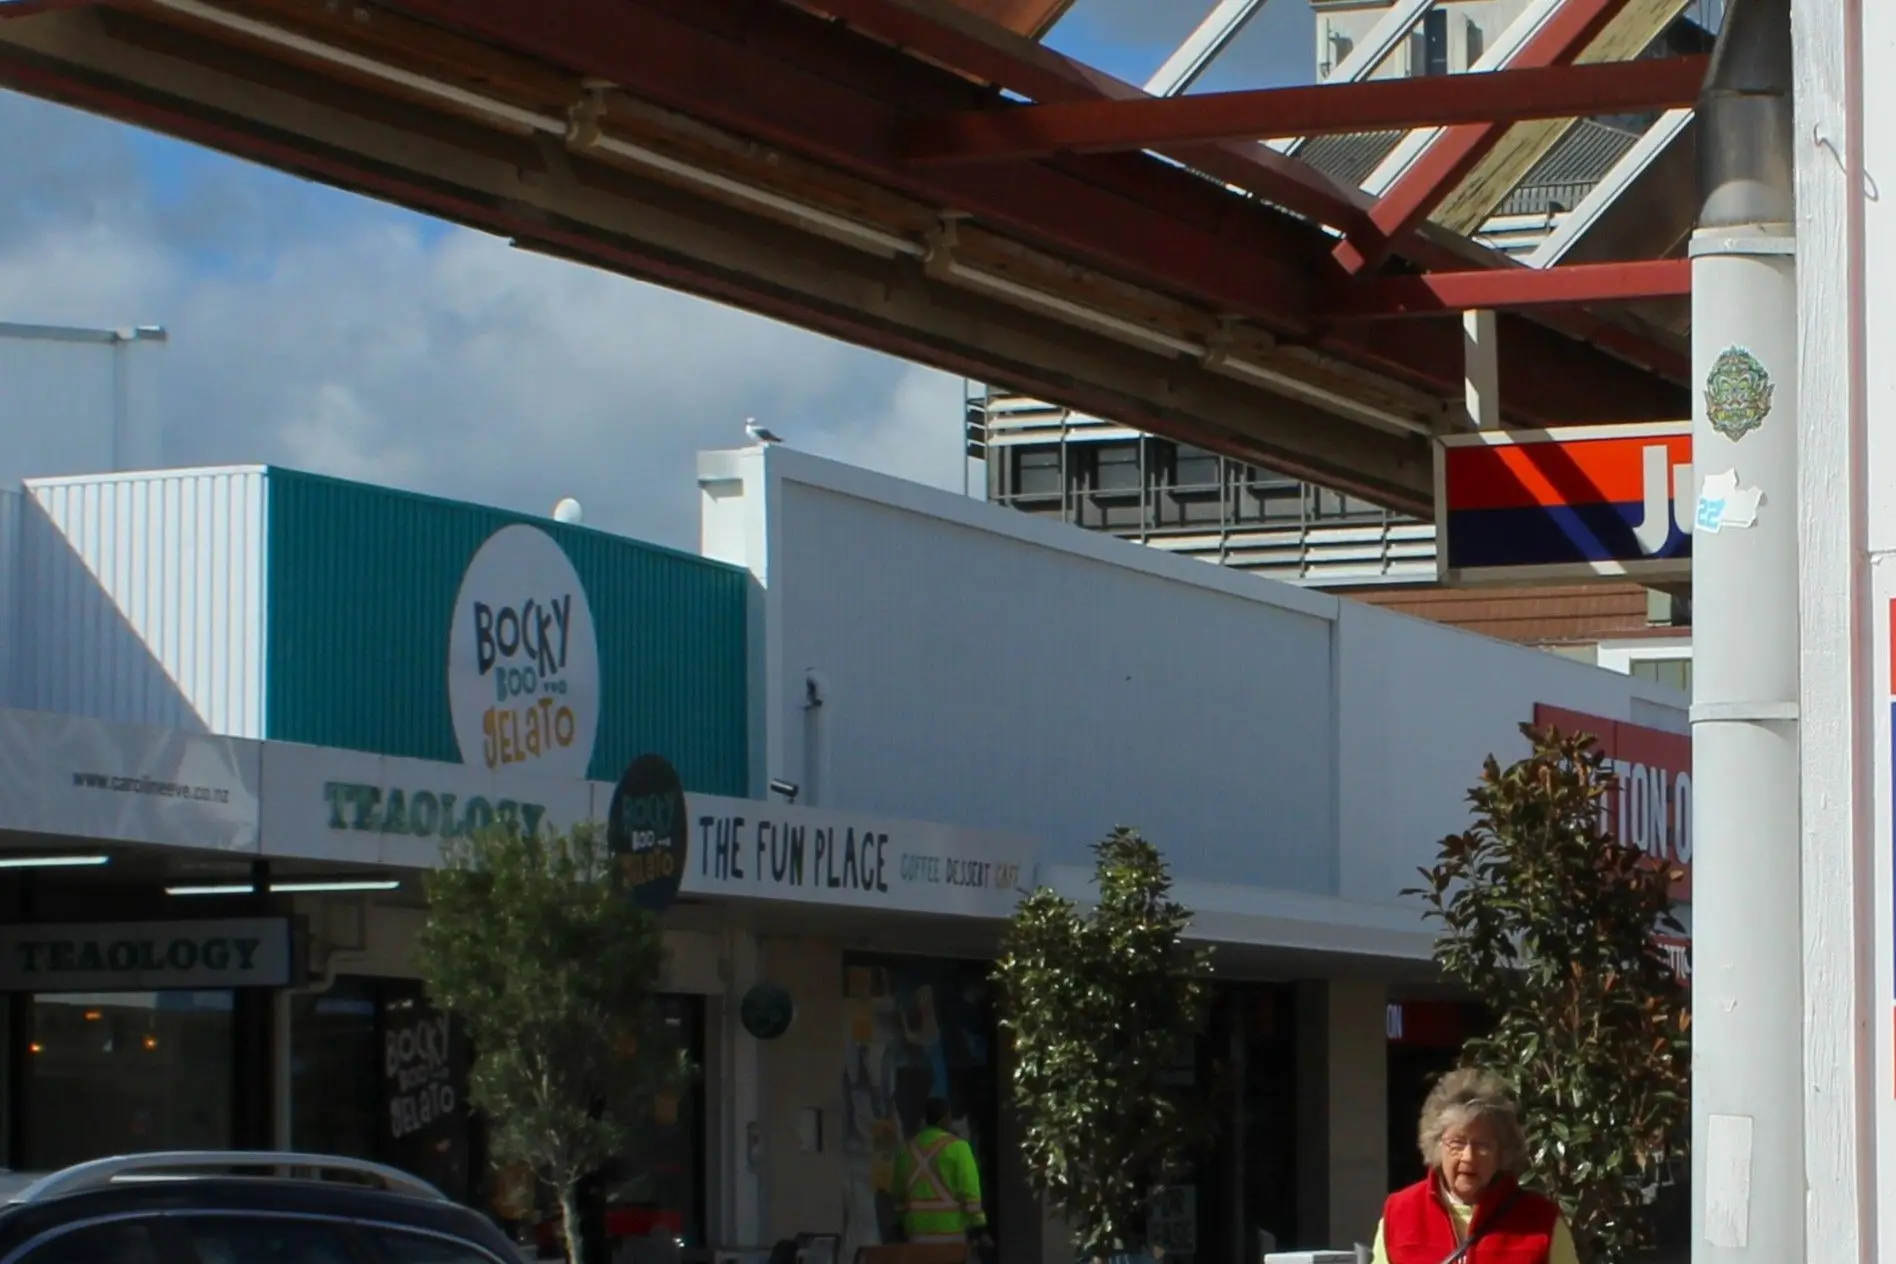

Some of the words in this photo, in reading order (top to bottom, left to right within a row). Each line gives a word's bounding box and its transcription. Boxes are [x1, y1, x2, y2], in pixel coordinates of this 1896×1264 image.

[473, 593, 572, 678] BOCKY
[495, 665, 537, 702] BOO
[1590, 757, 1668, 861] TTON
[699, 816, 745, 881] THE
[756, 820, 805, 886] FUN
[813, 826, 889, 893] PLACE
[946, 857, 991, 888] DESSERT
[18, 938, 261, 974] TEAOLOGY
[385, 1012, 450, 1078] BOCKY
